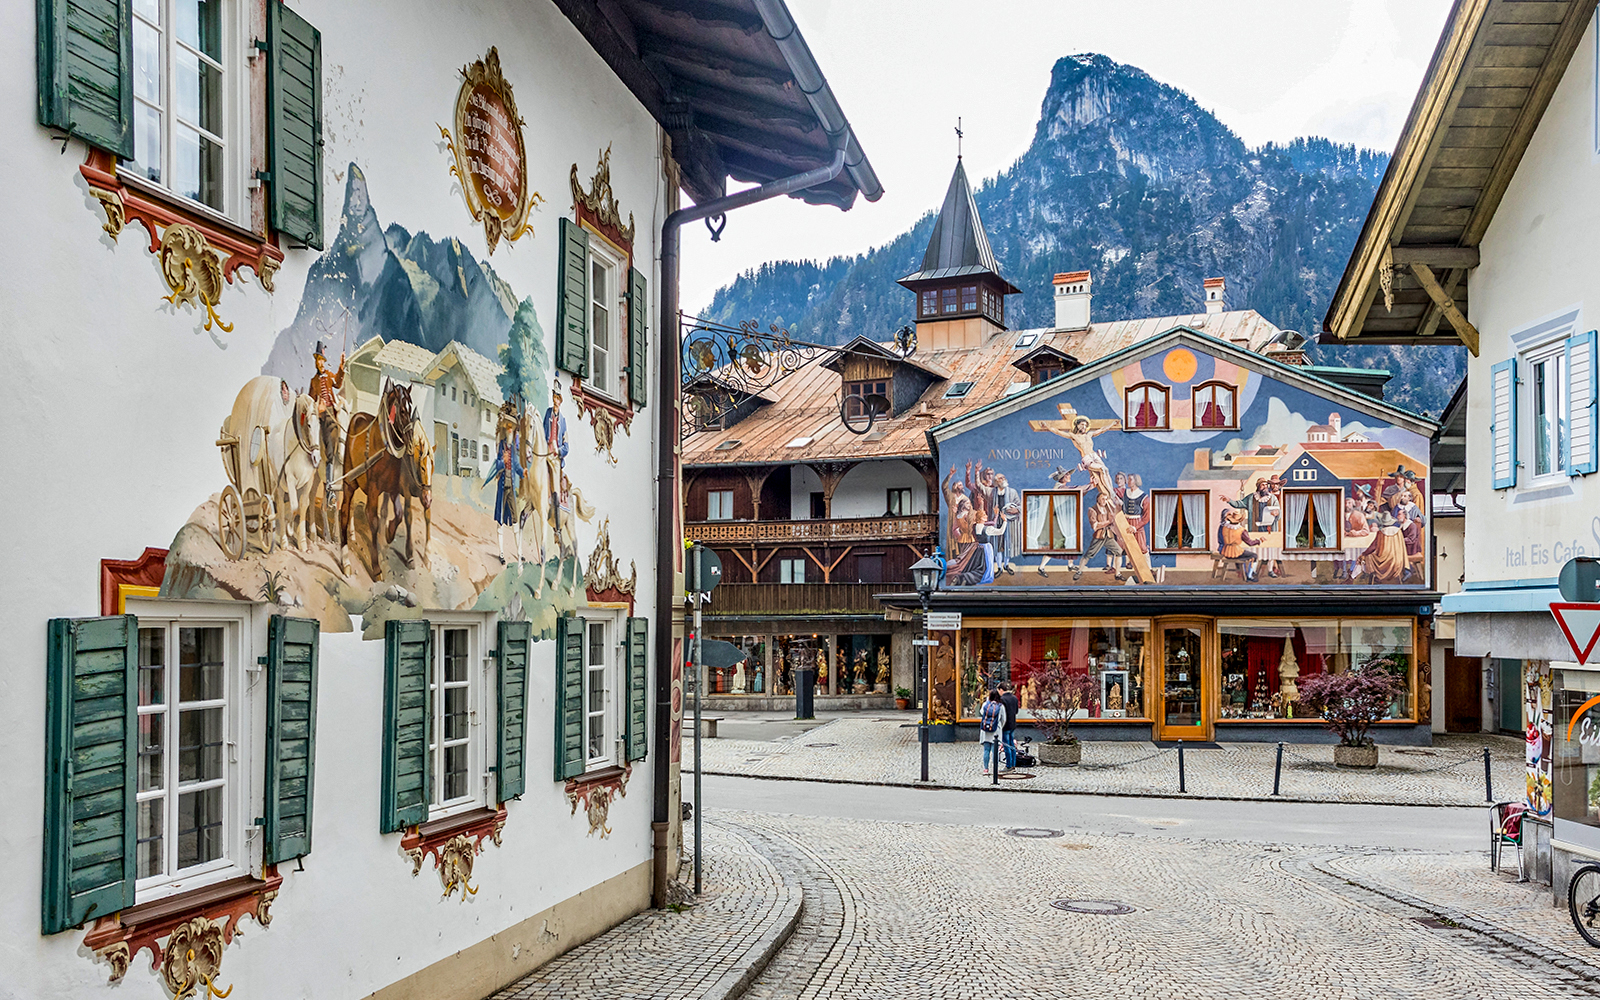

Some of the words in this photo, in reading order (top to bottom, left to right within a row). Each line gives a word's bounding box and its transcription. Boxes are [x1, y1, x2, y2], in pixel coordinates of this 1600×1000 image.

[988, 449, 1021, 460] ANNO
[1024, 449, 1064, 460] DOMINI
[1506, 545, 1527, 567] Ital.
[1531, 544, 1549, 565] Eis
[1553, 539, 1585, 564] Cafe
